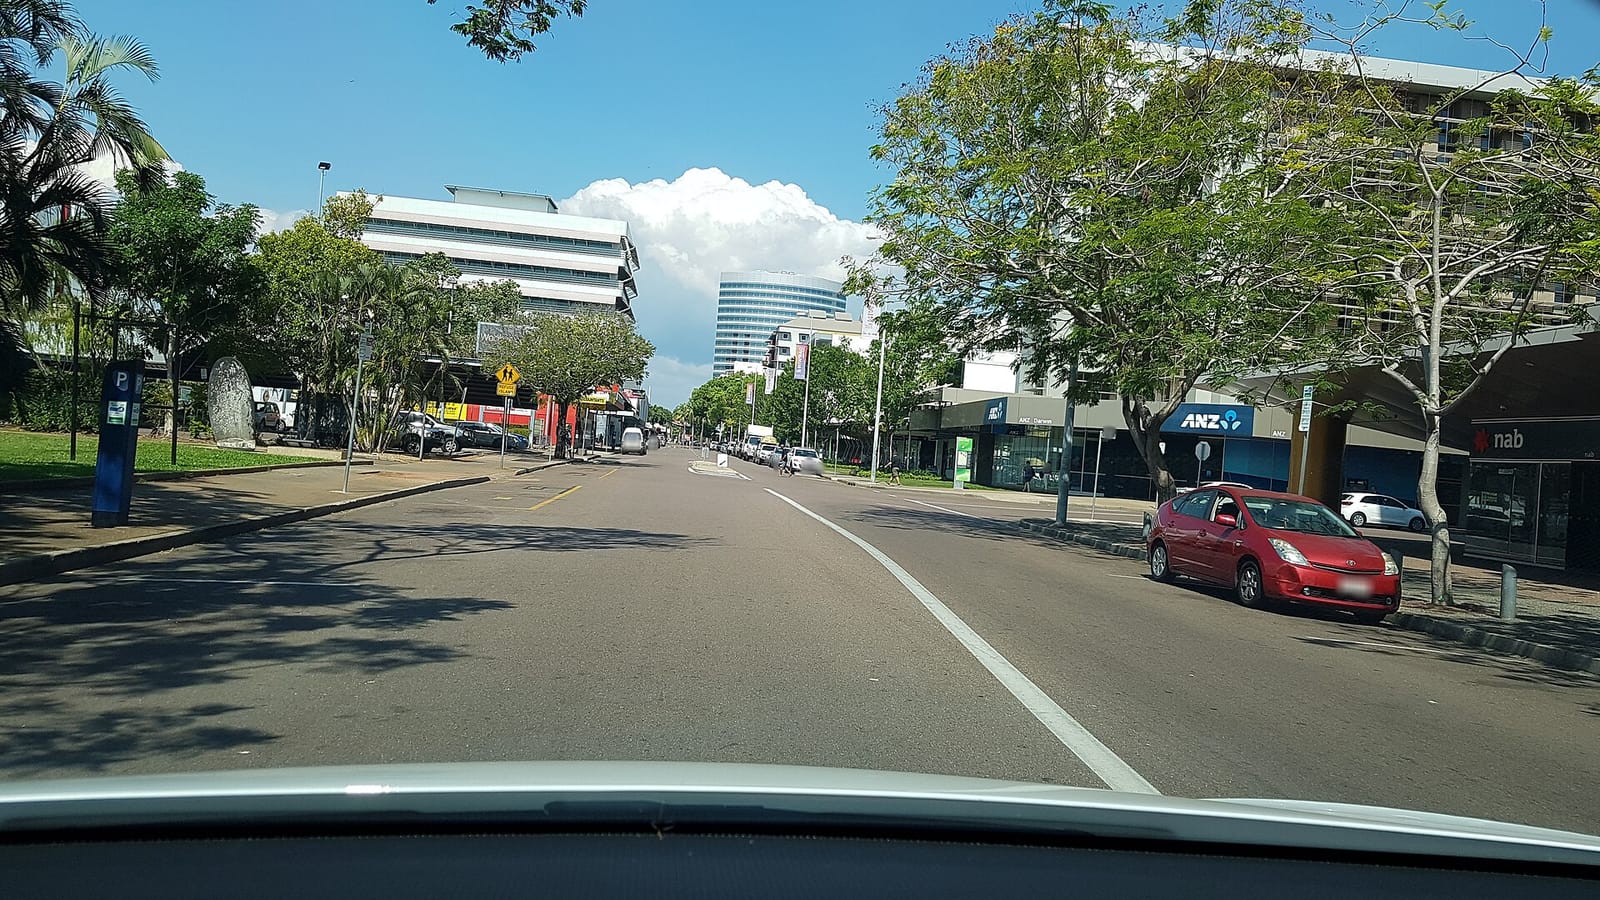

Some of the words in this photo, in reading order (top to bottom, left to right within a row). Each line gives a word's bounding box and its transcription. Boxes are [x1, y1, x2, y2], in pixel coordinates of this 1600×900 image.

[116, 371, 127, 387] P
[1181, 413, 1220, 429] ANZ
[1494, 429, 1524, 448] nab
